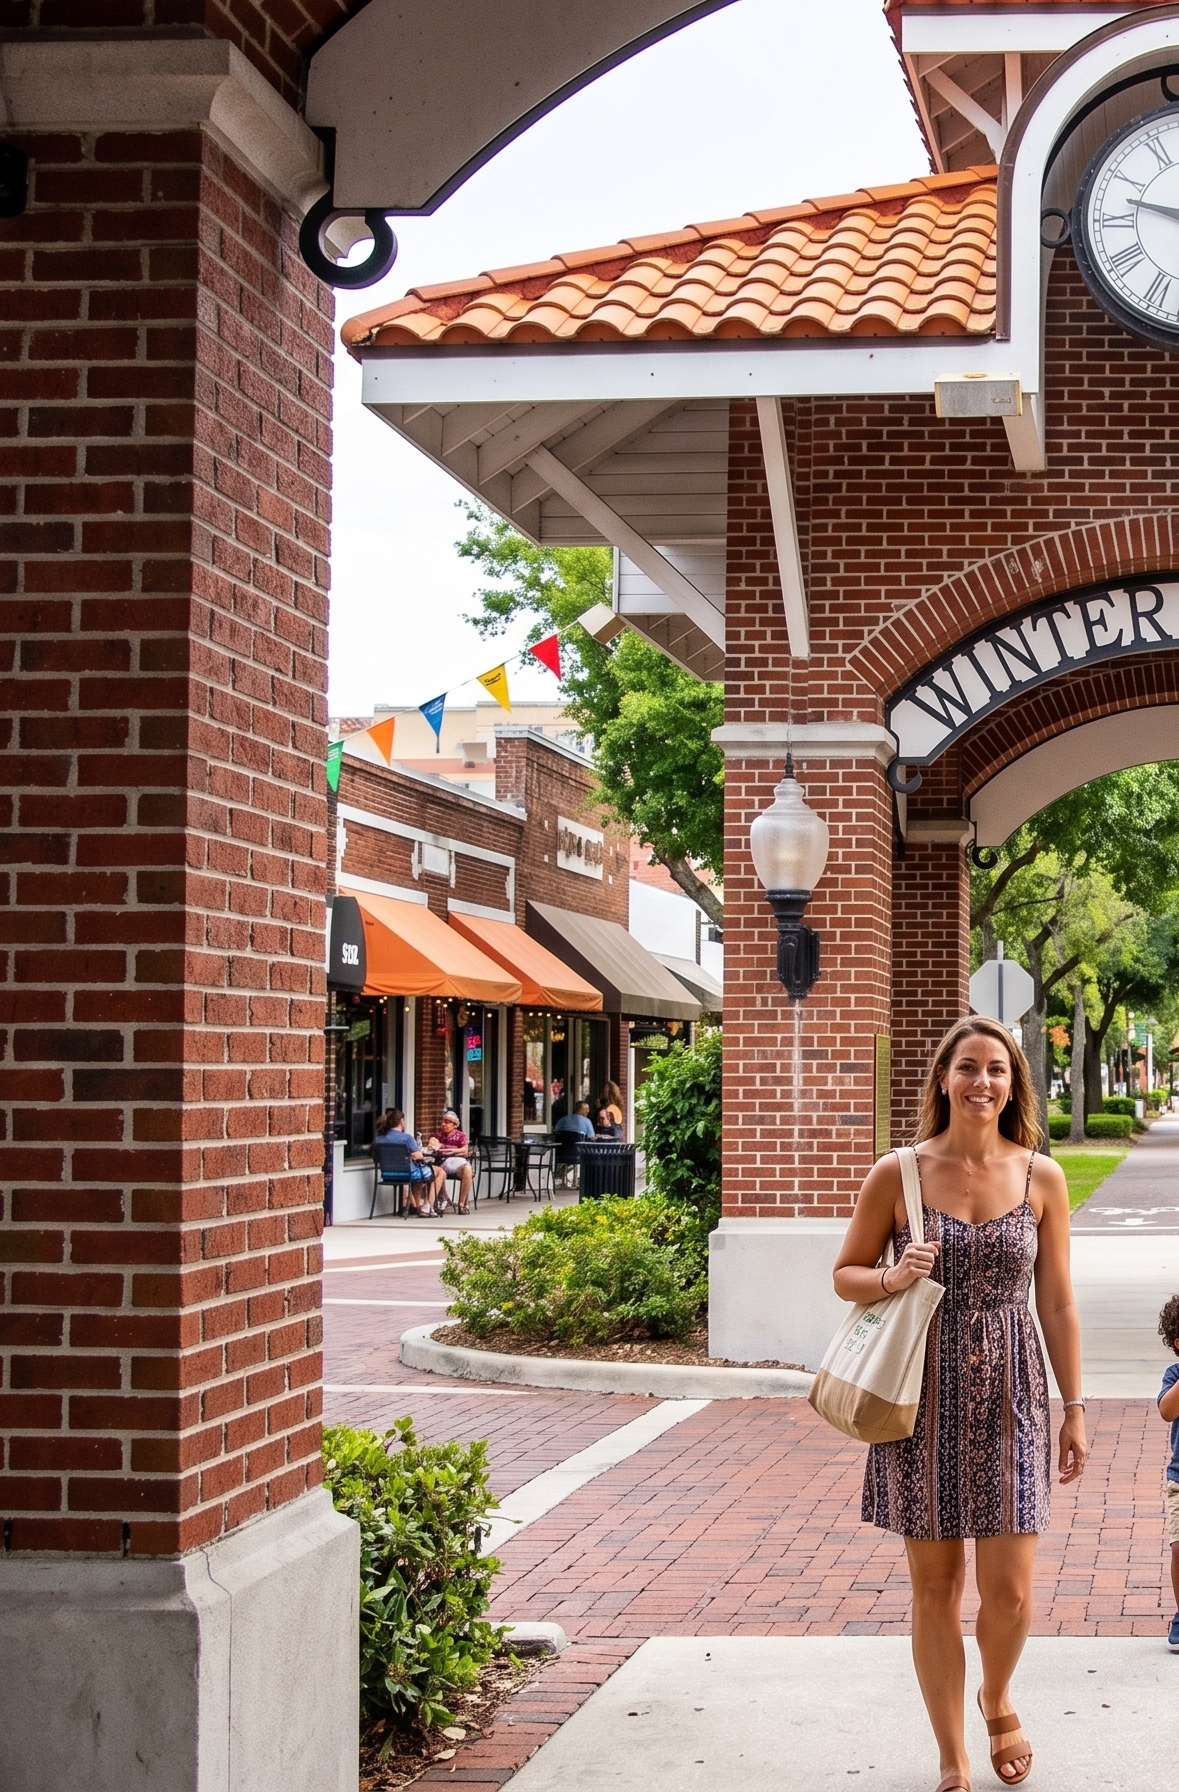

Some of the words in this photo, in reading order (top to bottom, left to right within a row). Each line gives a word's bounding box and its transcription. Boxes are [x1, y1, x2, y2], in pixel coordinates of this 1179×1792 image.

[1144, 136, 1173, 171] XI
[1114, 170, 1145, 193] X
[1103, 212, 1134, 229] IX
[1110, 242, 1145, 278] VIII
[1143, 271, 1173, 309] VII
[905, 584, 1175, 733] WINTER
